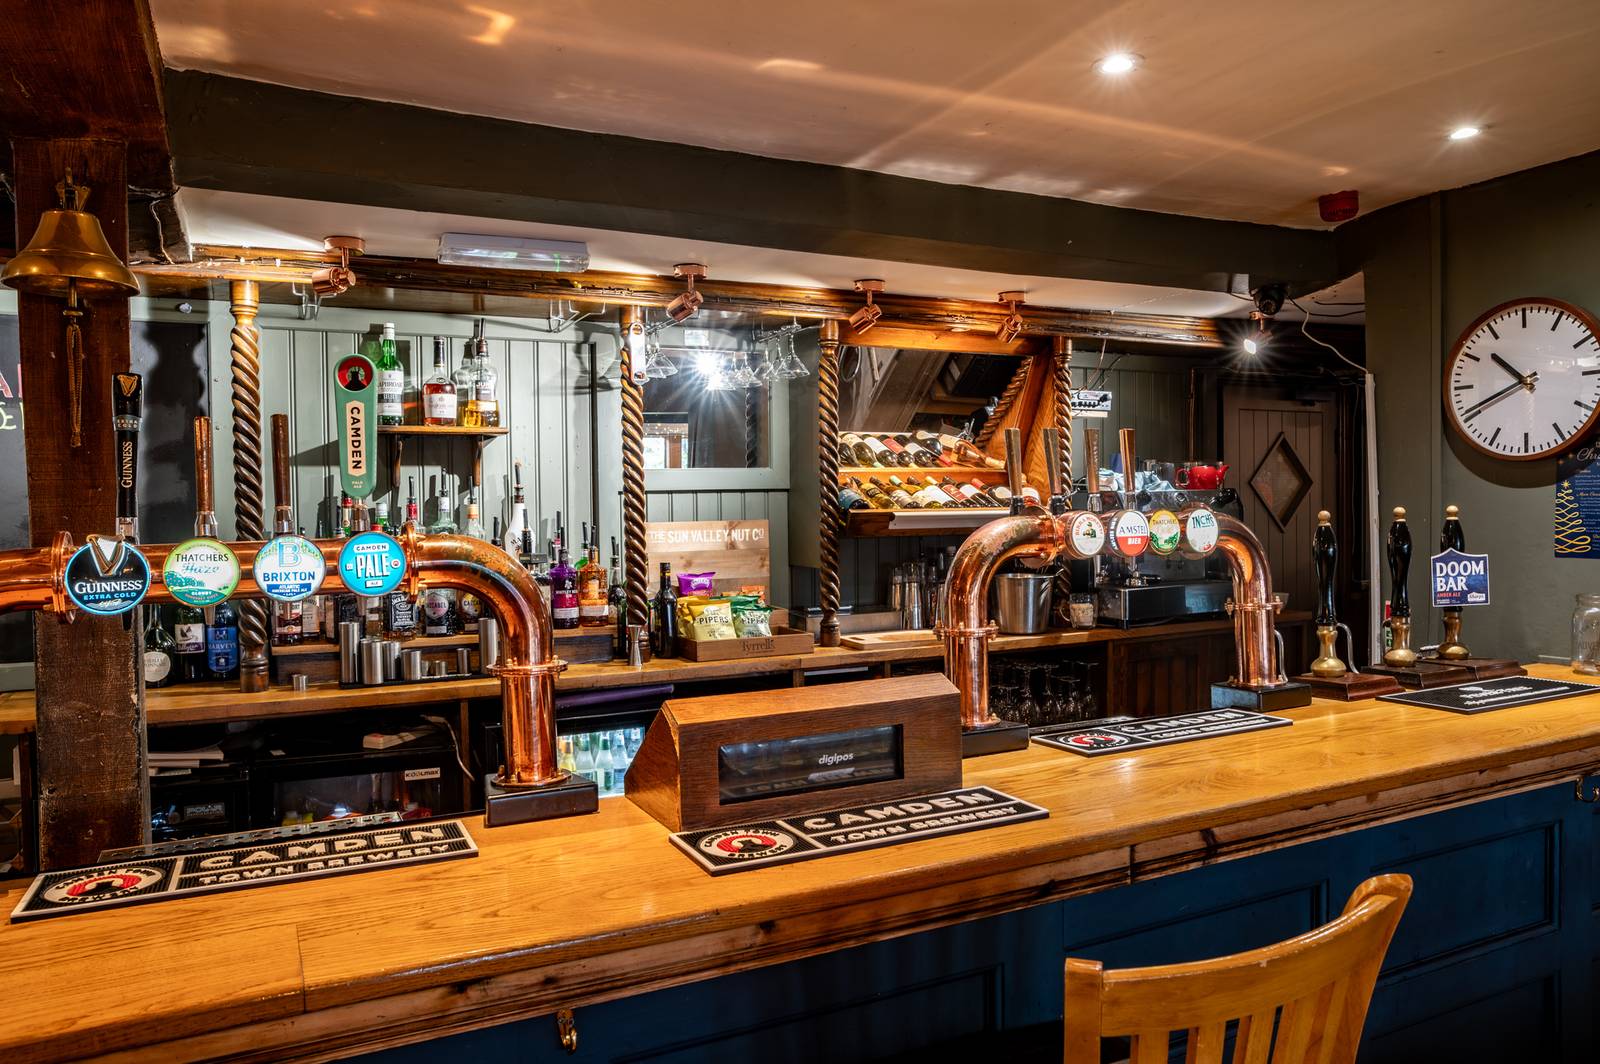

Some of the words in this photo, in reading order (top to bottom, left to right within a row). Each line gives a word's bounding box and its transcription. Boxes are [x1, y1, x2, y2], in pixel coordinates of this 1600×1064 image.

[350, 406, 362, 469] CAMDEN
[121, 441, 133, 488] GUINNESS
[667, 531, 689, 543] SUN
[690, 529, 729, 543] VALLEY
[731, 529, 751, 541] NUT
[1119, 526, 1147, 535] AMSTEL
[175, 553, 229, 562] THATCHERS
[355, 553, 391, 579] PALE
[1436, 560, 1484, 577] DOOM
[263, 571, 315, 581] BRIXTON
[1436, 576, 1468, 592] BAR
[74, 579, 143, 594] GUINNESS
[83, 592, 111, 600] EXTRA
[114, 590, 137, 599] COLD
[699, 615, 730, 625] PIPERS
[818, 752, 854, 766] digipos
[803, 791, 995, 831] CAMDEN
[830, 825, 906, 845] TOWN
[908, 806, 1019, 831] BREWERY
[704, 829, 739, 848] CAMDEN
[198, 827, 446, 870] CAMDEN
[197, 865, 295, 886] TOWN
[306, 843, 450, 871] BREWERY
